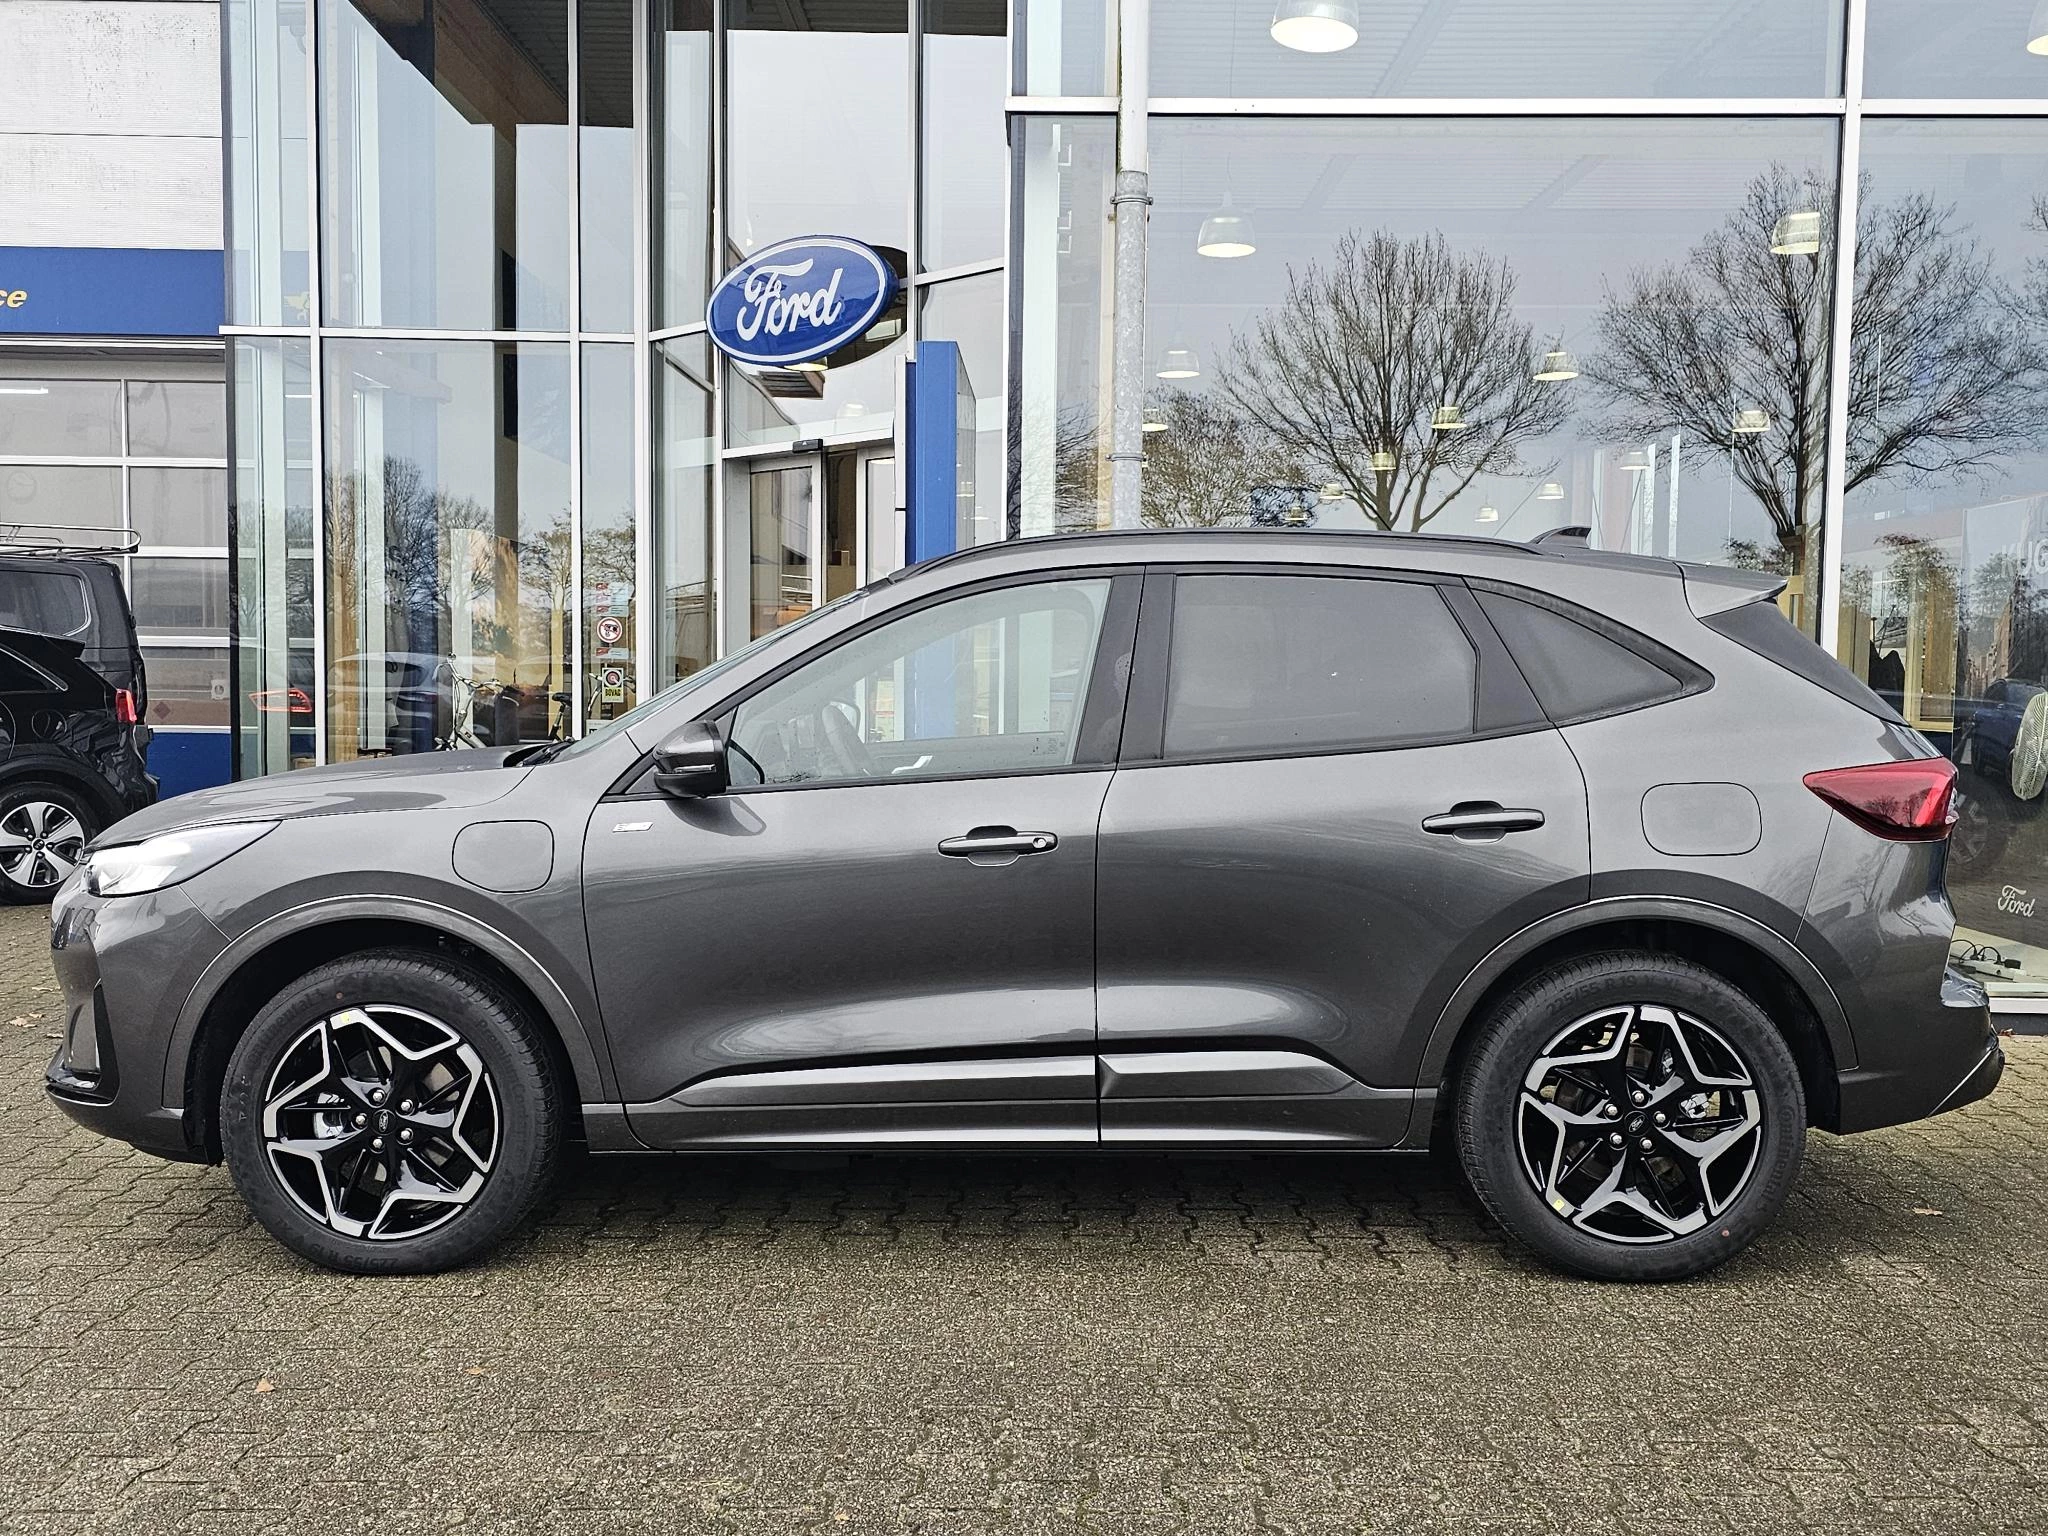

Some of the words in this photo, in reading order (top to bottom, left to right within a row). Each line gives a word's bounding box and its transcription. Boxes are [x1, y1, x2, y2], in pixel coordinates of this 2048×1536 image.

[737, 258, 843, 341] Ford
[605, 688, 621, 697] BOVAG
[1997, 885, 2036, 917] Ford
